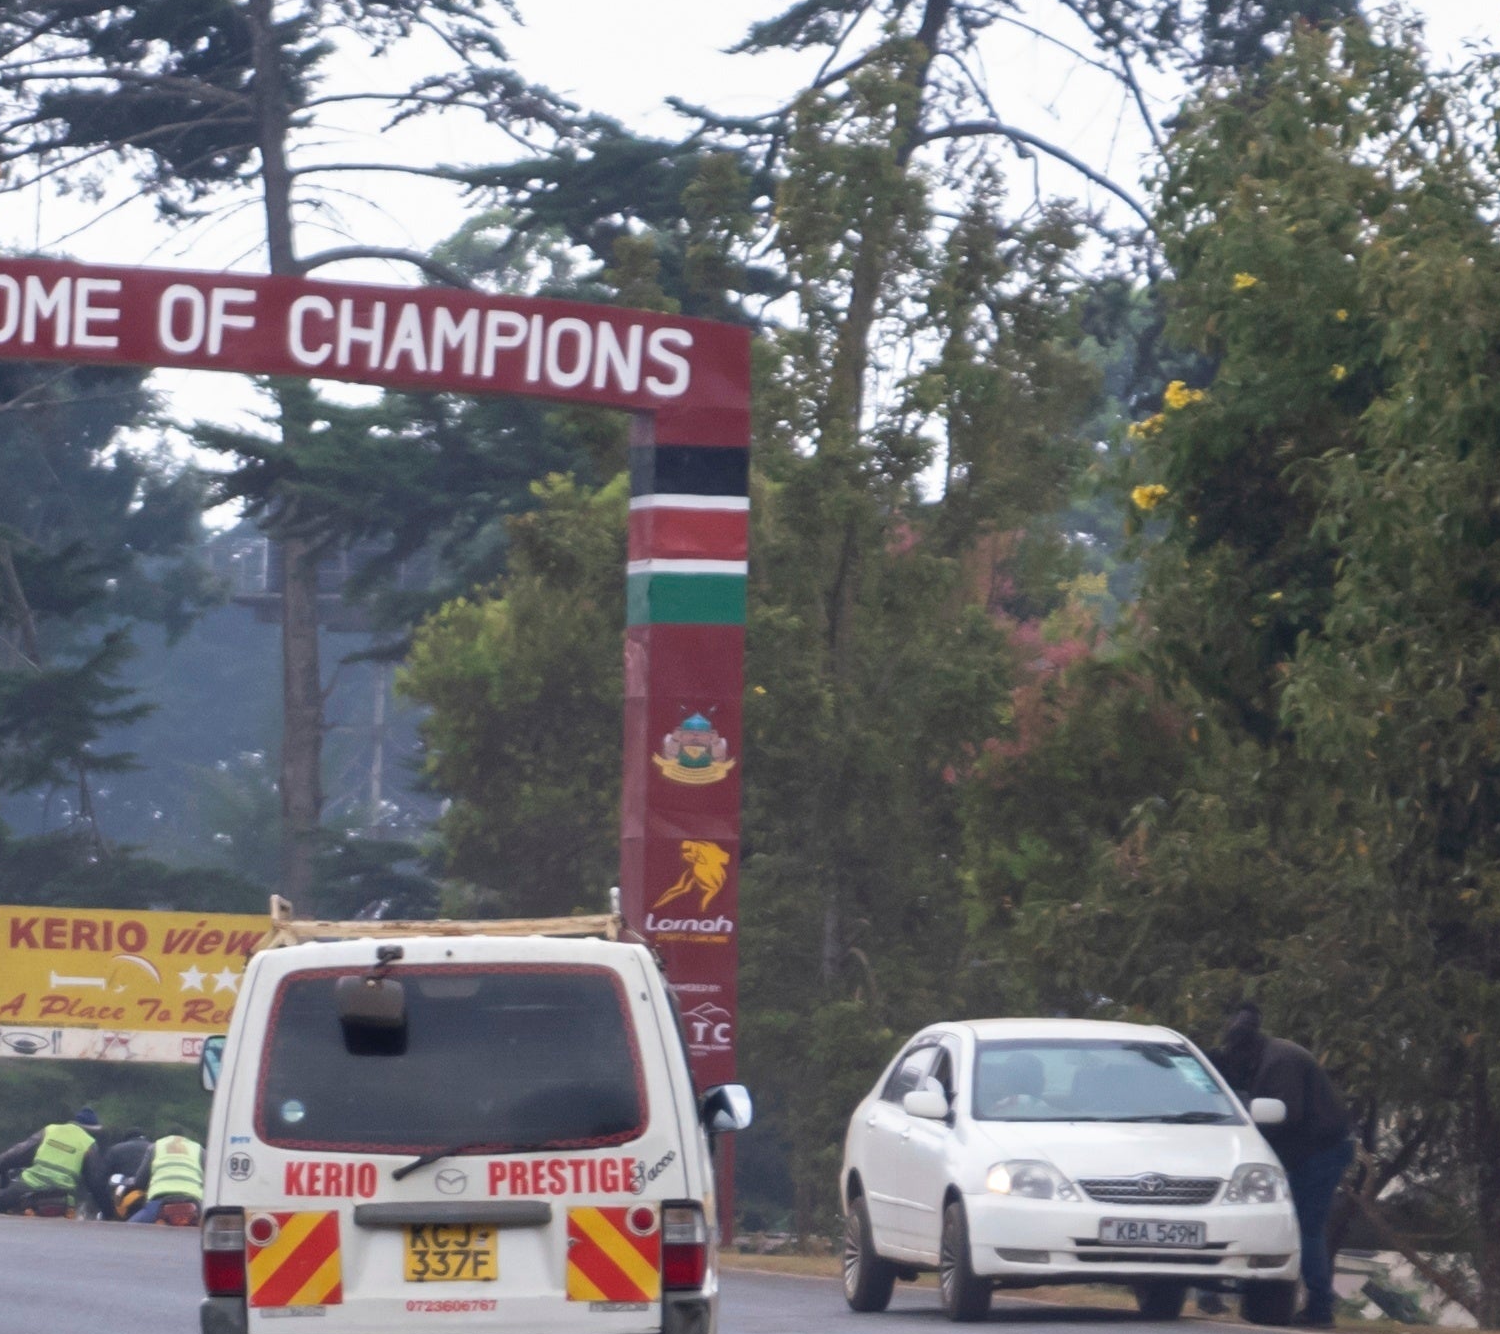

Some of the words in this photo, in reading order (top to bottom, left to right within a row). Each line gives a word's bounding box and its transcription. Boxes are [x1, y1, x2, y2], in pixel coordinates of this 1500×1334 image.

[158, 283, 258, 356] OF
[288, 294, 694, 398] CHAMPIONS
[10, 917, 148, 953] KERIO
[161, 921, 267, 956] view
[645, 913, 734, 933] Lornah
[40, 994, 125, 1021] Place
[137, 998, 172, 1022] To
[230, 1157, 250, 1172] 80
[284, 1161, 378, 1198] KERIO
[488, 1157, 636, 1196] PRESTIGE
[1116, 1223, 1149, 1240] KBA
[411, 1250, 490, 1278] 337F
